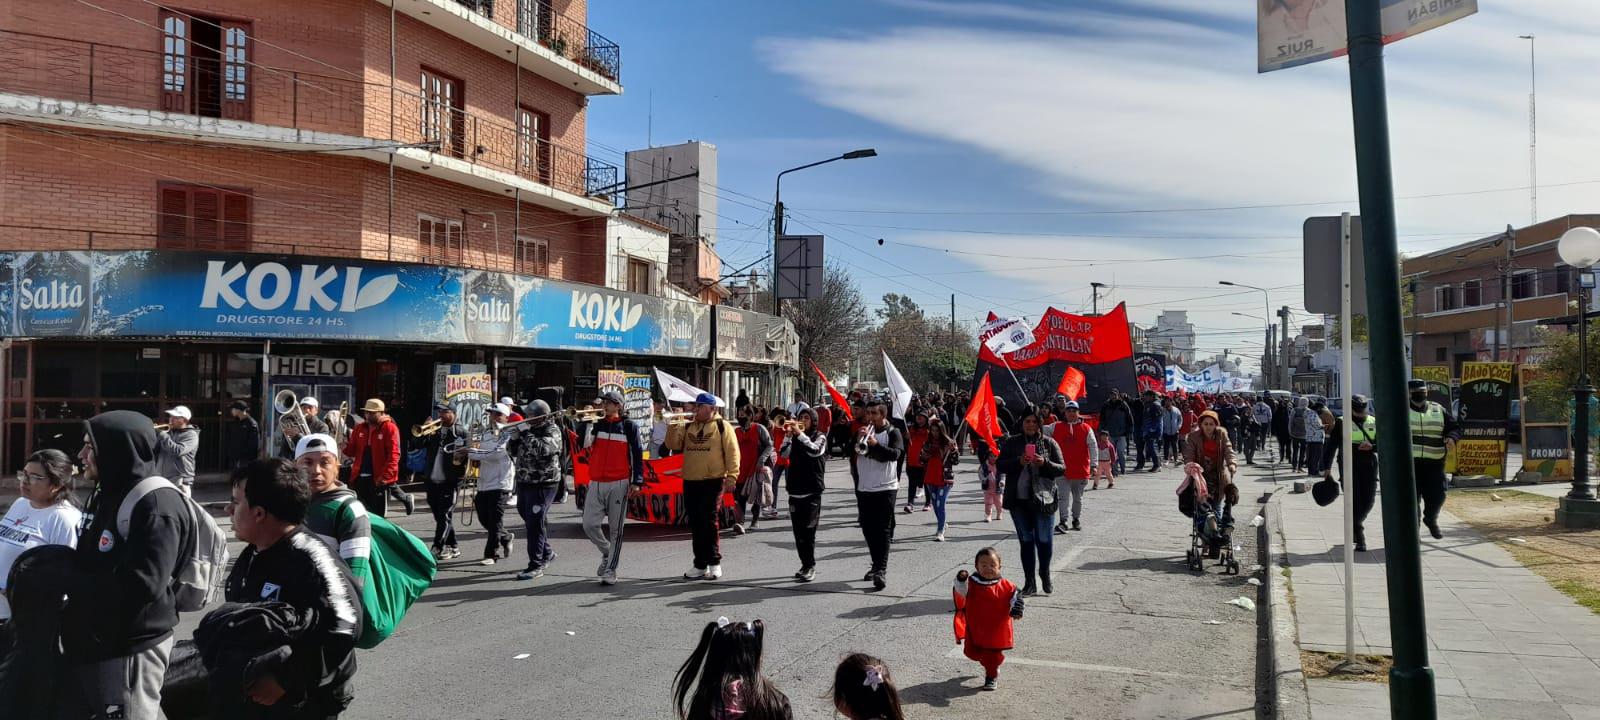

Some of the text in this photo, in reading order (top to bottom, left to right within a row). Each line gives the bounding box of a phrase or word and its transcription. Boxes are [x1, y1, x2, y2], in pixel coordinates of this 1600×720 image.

[21, 278, 86, 311] Salta
[199, 260, 363, 313] KOKI
[467, 293, 511, 322] Salta
[568, 290, 629, 332] KOKI
[216, 314, 304, 325] DRUGSTORE
[308, 316, 323, 325] 24
[671, 318, 692, 339] Salta
[575, 333, 607, 342] DRUGSTORE
[278, 358, 348, 375] HIELO
[1463, 365, 1488, 381] BAJO
[447, 377, 467, 394] BAJO
[470, 376, 490, 392] COCA
[457, 391, 480, 402] DESDE
[1531, 448, 1562, 458] PROMO
